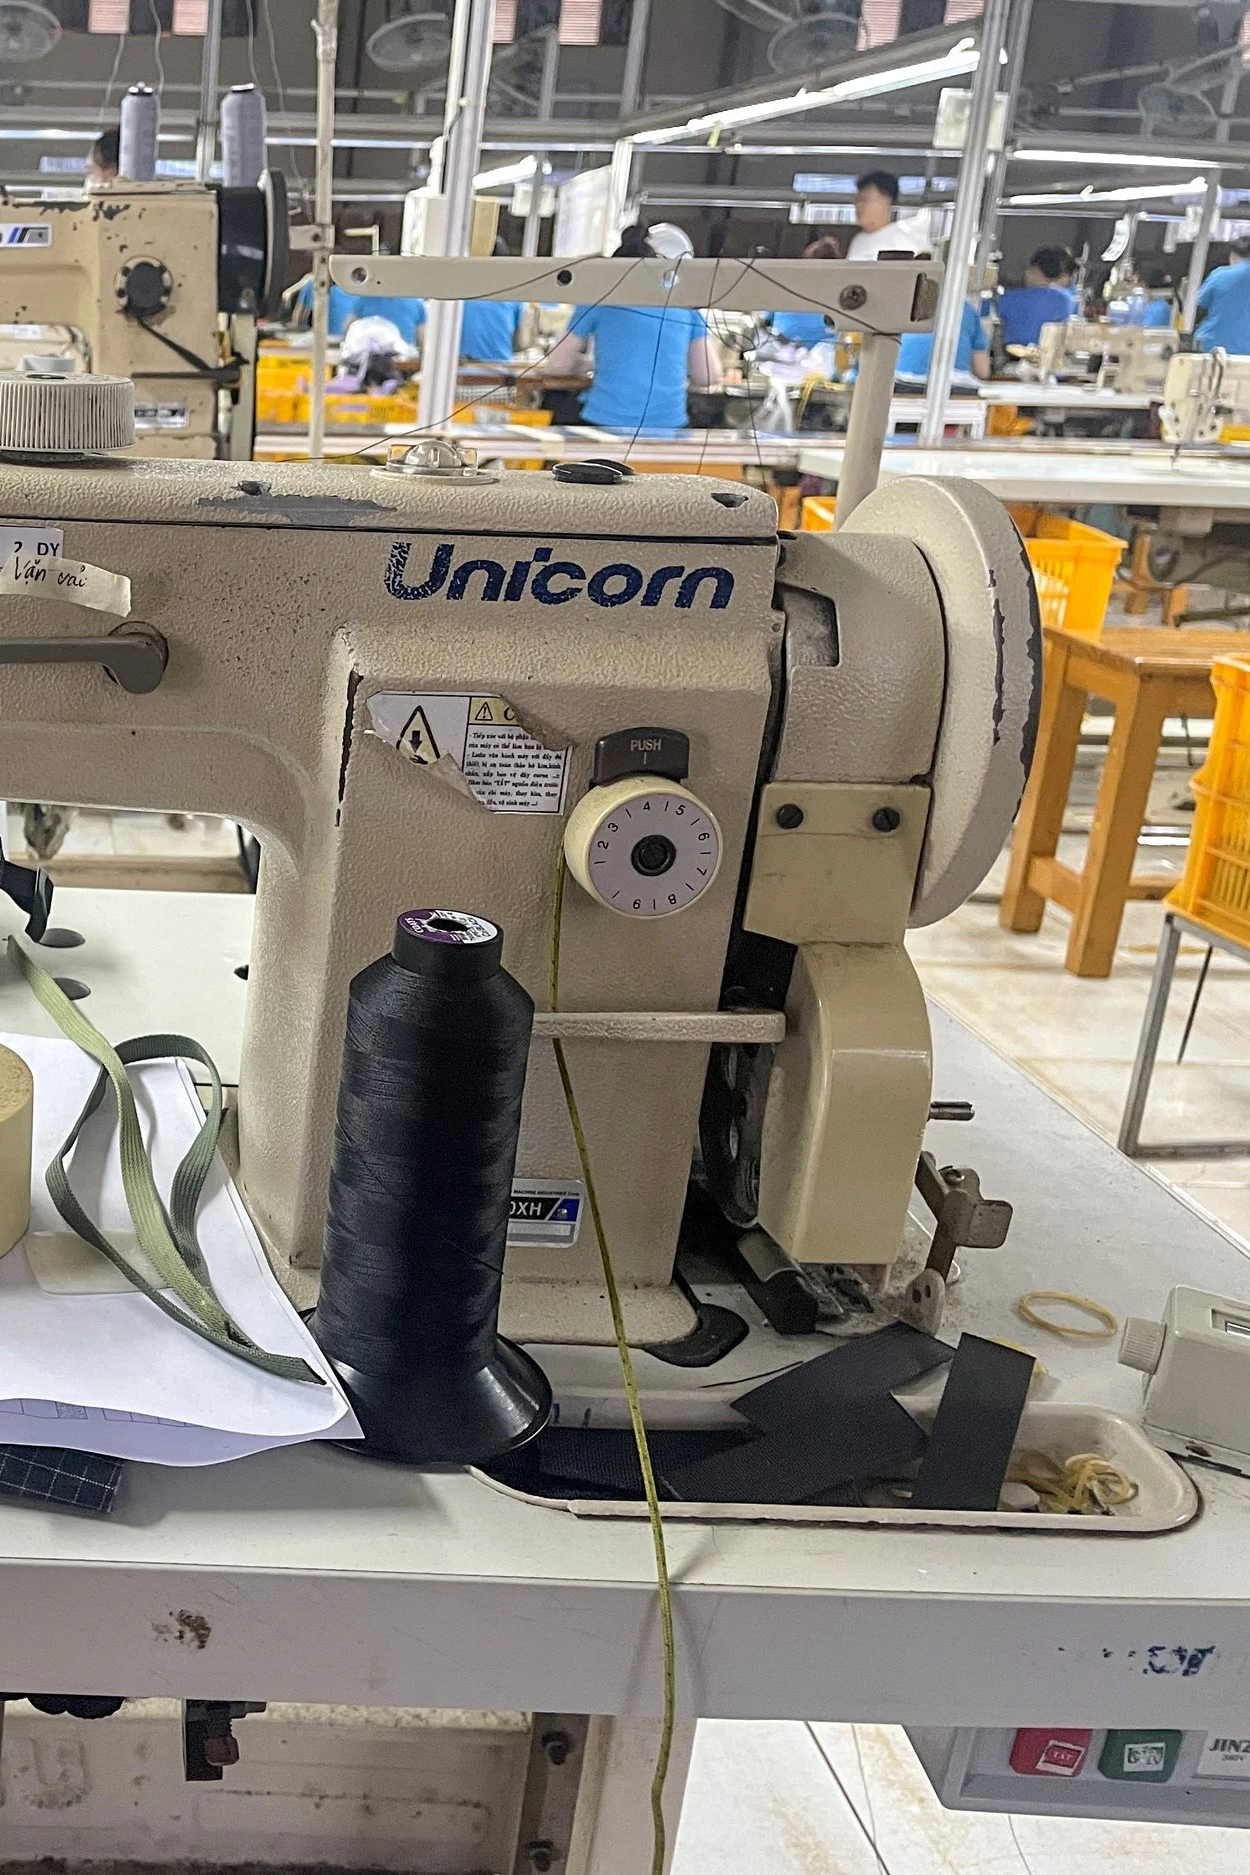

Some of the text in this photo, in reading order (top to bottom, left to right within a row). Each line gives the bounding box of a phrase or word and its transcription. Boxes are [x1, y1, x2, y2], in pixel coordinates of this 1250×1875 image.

[37, 542, 60, 557] DY
[385, 540, 735, 610] Unicorn
[630, 739, 661, 751] PUSH
[643, 802, 650, 811] 4
[676, 804, 686, 816] 5
[608, 822, 618, 832] 3
[698, 832, 710, 841] 6
[598, 840, 609, 849] 2
[697, 868, 707, 876] 7
[633, 898, 642, 909] 9
[668, 894, 677, 904] 8
